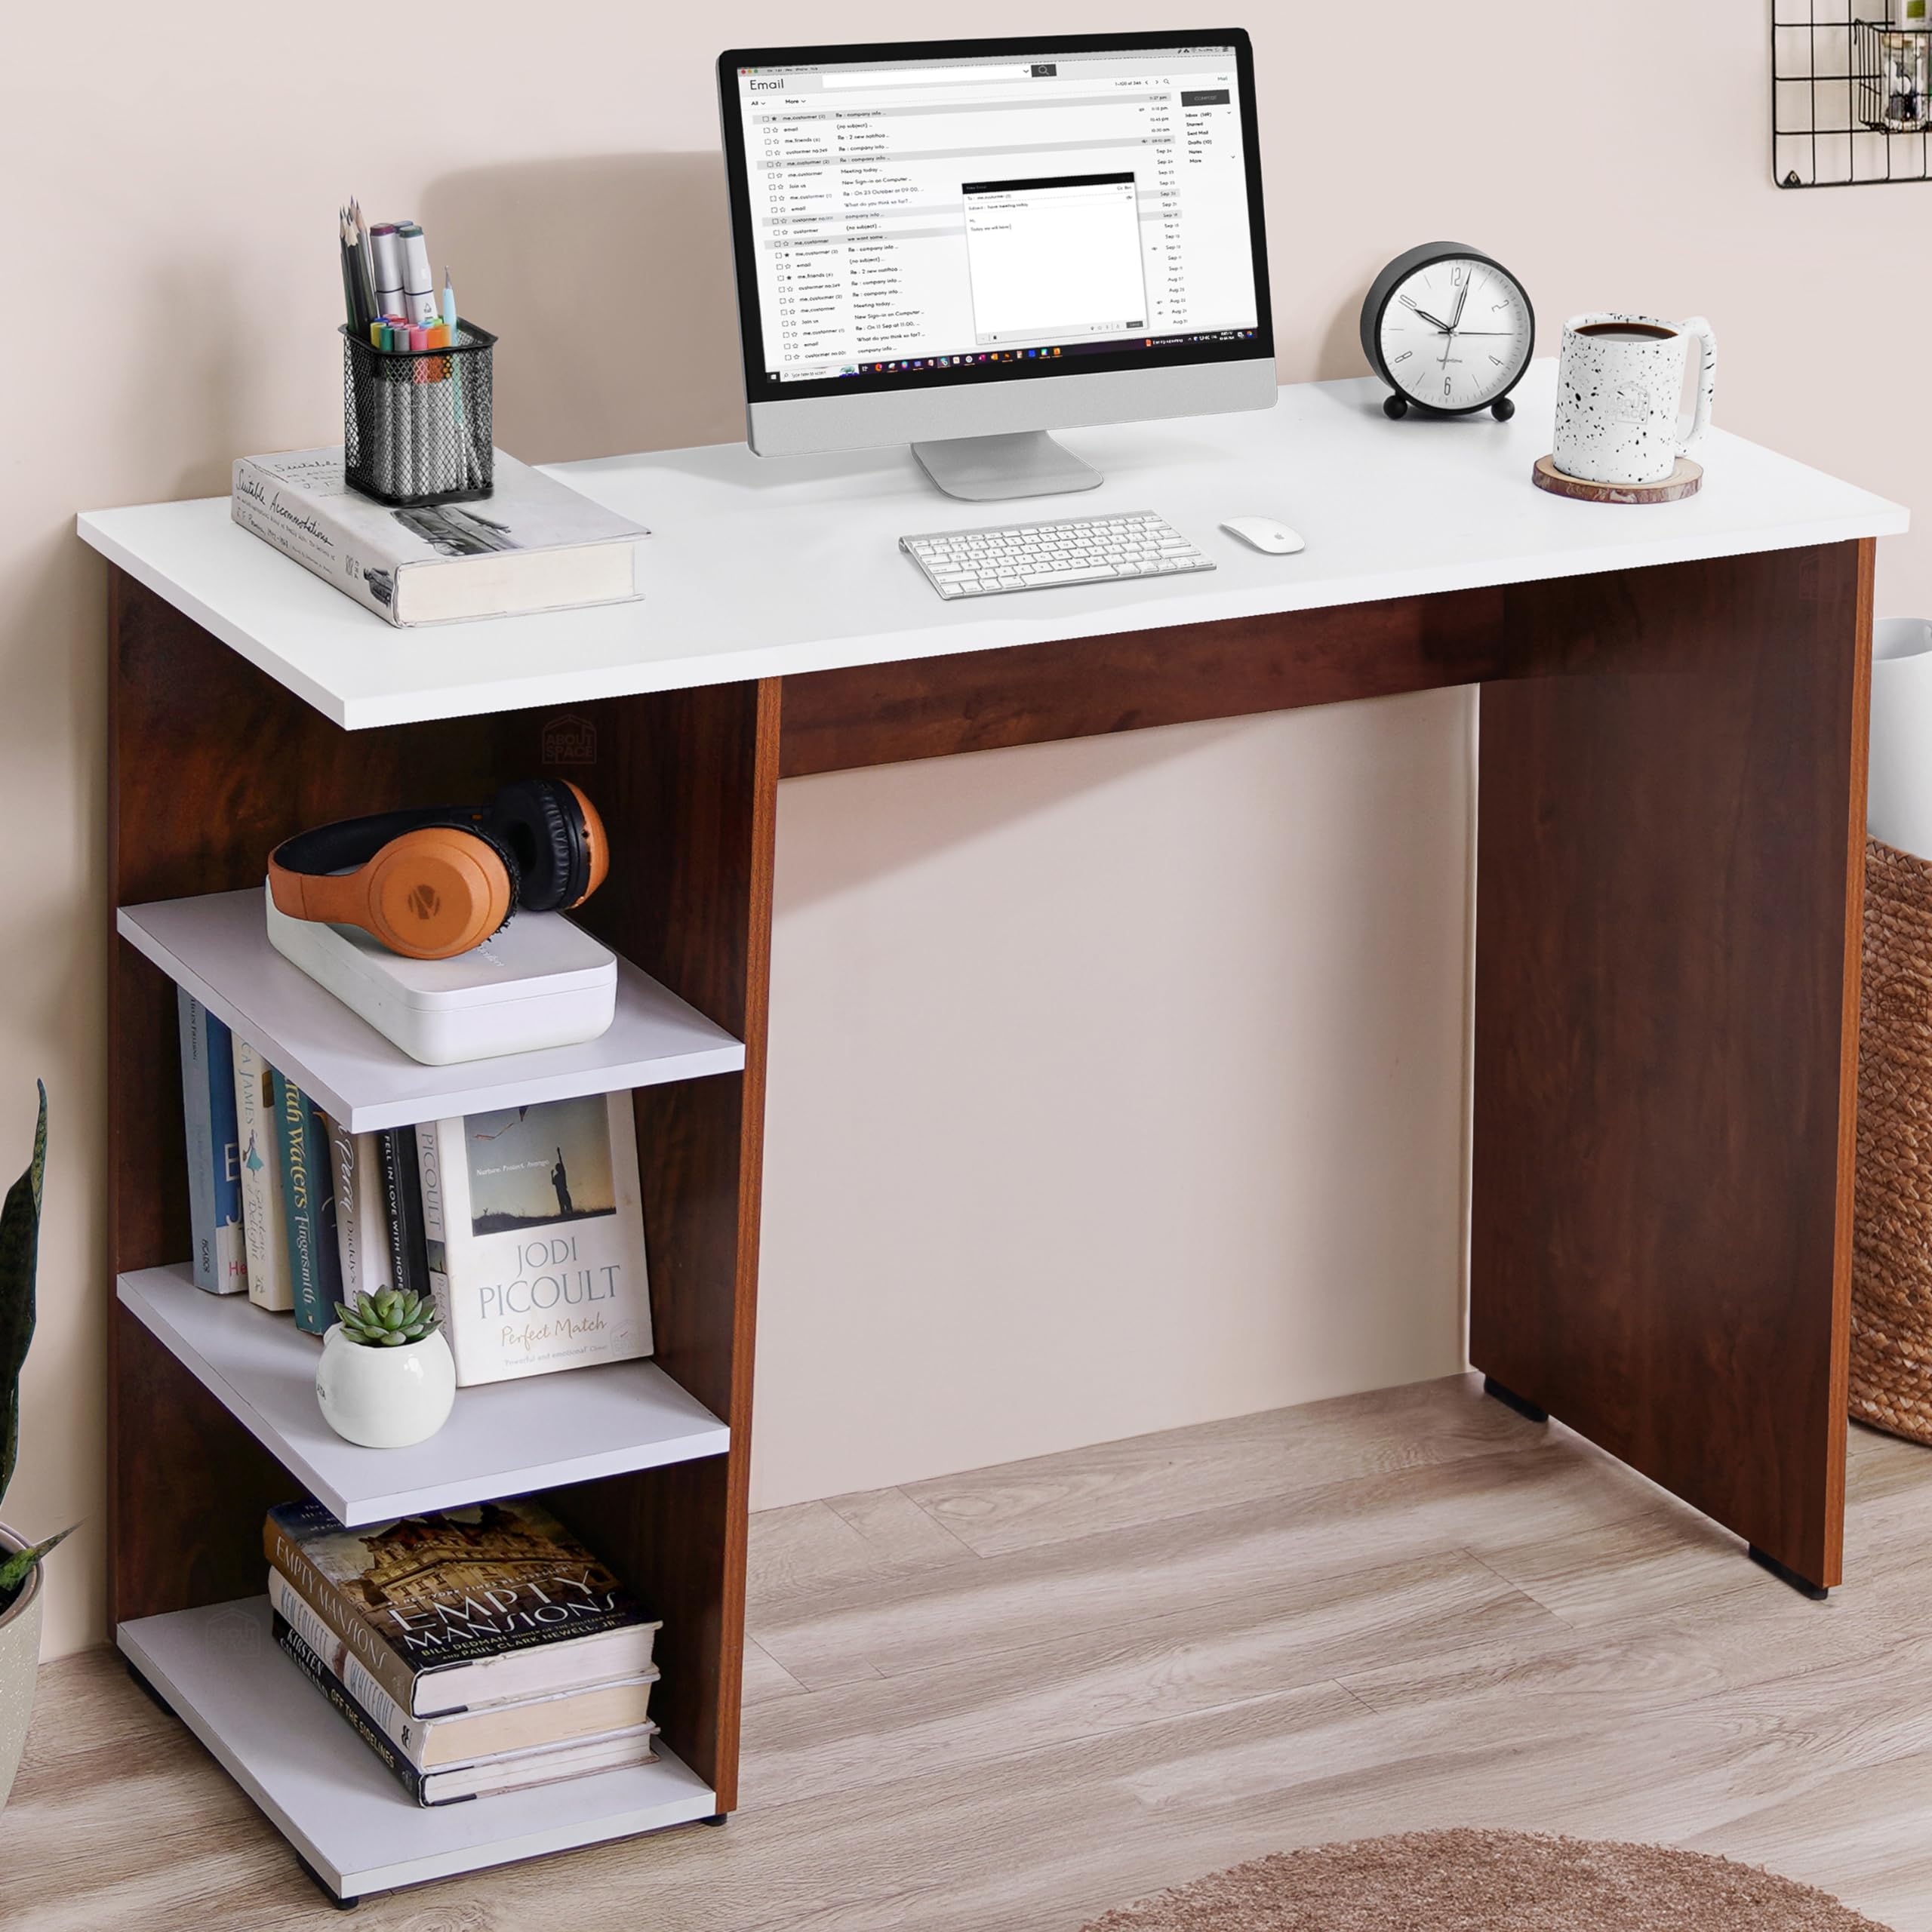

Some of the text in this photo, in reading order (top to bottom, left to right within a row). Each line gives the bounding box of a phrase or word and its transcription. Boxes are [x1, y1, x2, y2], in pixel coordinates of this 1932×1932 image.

[750, 78, 784, 90] Email
[1450, 266, 1462, 287] 12
[1397, 294, 1417, 311] 10
[1491, 299, 1509, 313] 2
[1487, 355, 1505, 367] 4
[1443, 377, 1452, 396] 6
[235, 469, 266, 506] Suitable
[238, 1068, 255, 1124] JAMES
[285, 1077, 304, 1124] rah
[422, 1133, 441, 1232] PICOULT
[383, 1135, 404, 1290] FELL IN LOVE WITH HOPE
[294, 1211, 316, 1306] Fingersmith
[516, 1236, 578, 1278] JODI
[479, 1265, 620, 1320] PICOULT
[501, 1311, 608, 1352] Perfect Match
[537, 1352, 551, 1361] and
[275, 1536, 317, 1594] EMPTY
[318, 1583, 388, 1669] MANSIONS
[386, 1570, 592, 1632] EMPTY
[403, 1594, 431, 1604] NEW
[432, 1589, 460, 1599] YORK
[465, 1582, 499, 1592] TIMES
[403, 1592, 616, 1651] MANSIONS
[281, 1584, 396, 1735] KEN FOLLETT WHITEOUT
[287, 1628, 325, 1677] KIRSTEN
[420, 1645, 449, 1657] BILL
[452, 1635, 508, 1651] DEDMAN
[461, 1644, 494, 1657] PAUL
[497, 1635, 540, 1651] CLARK
[331, 1688, 396, 1769] OFF THE SIDELINES
